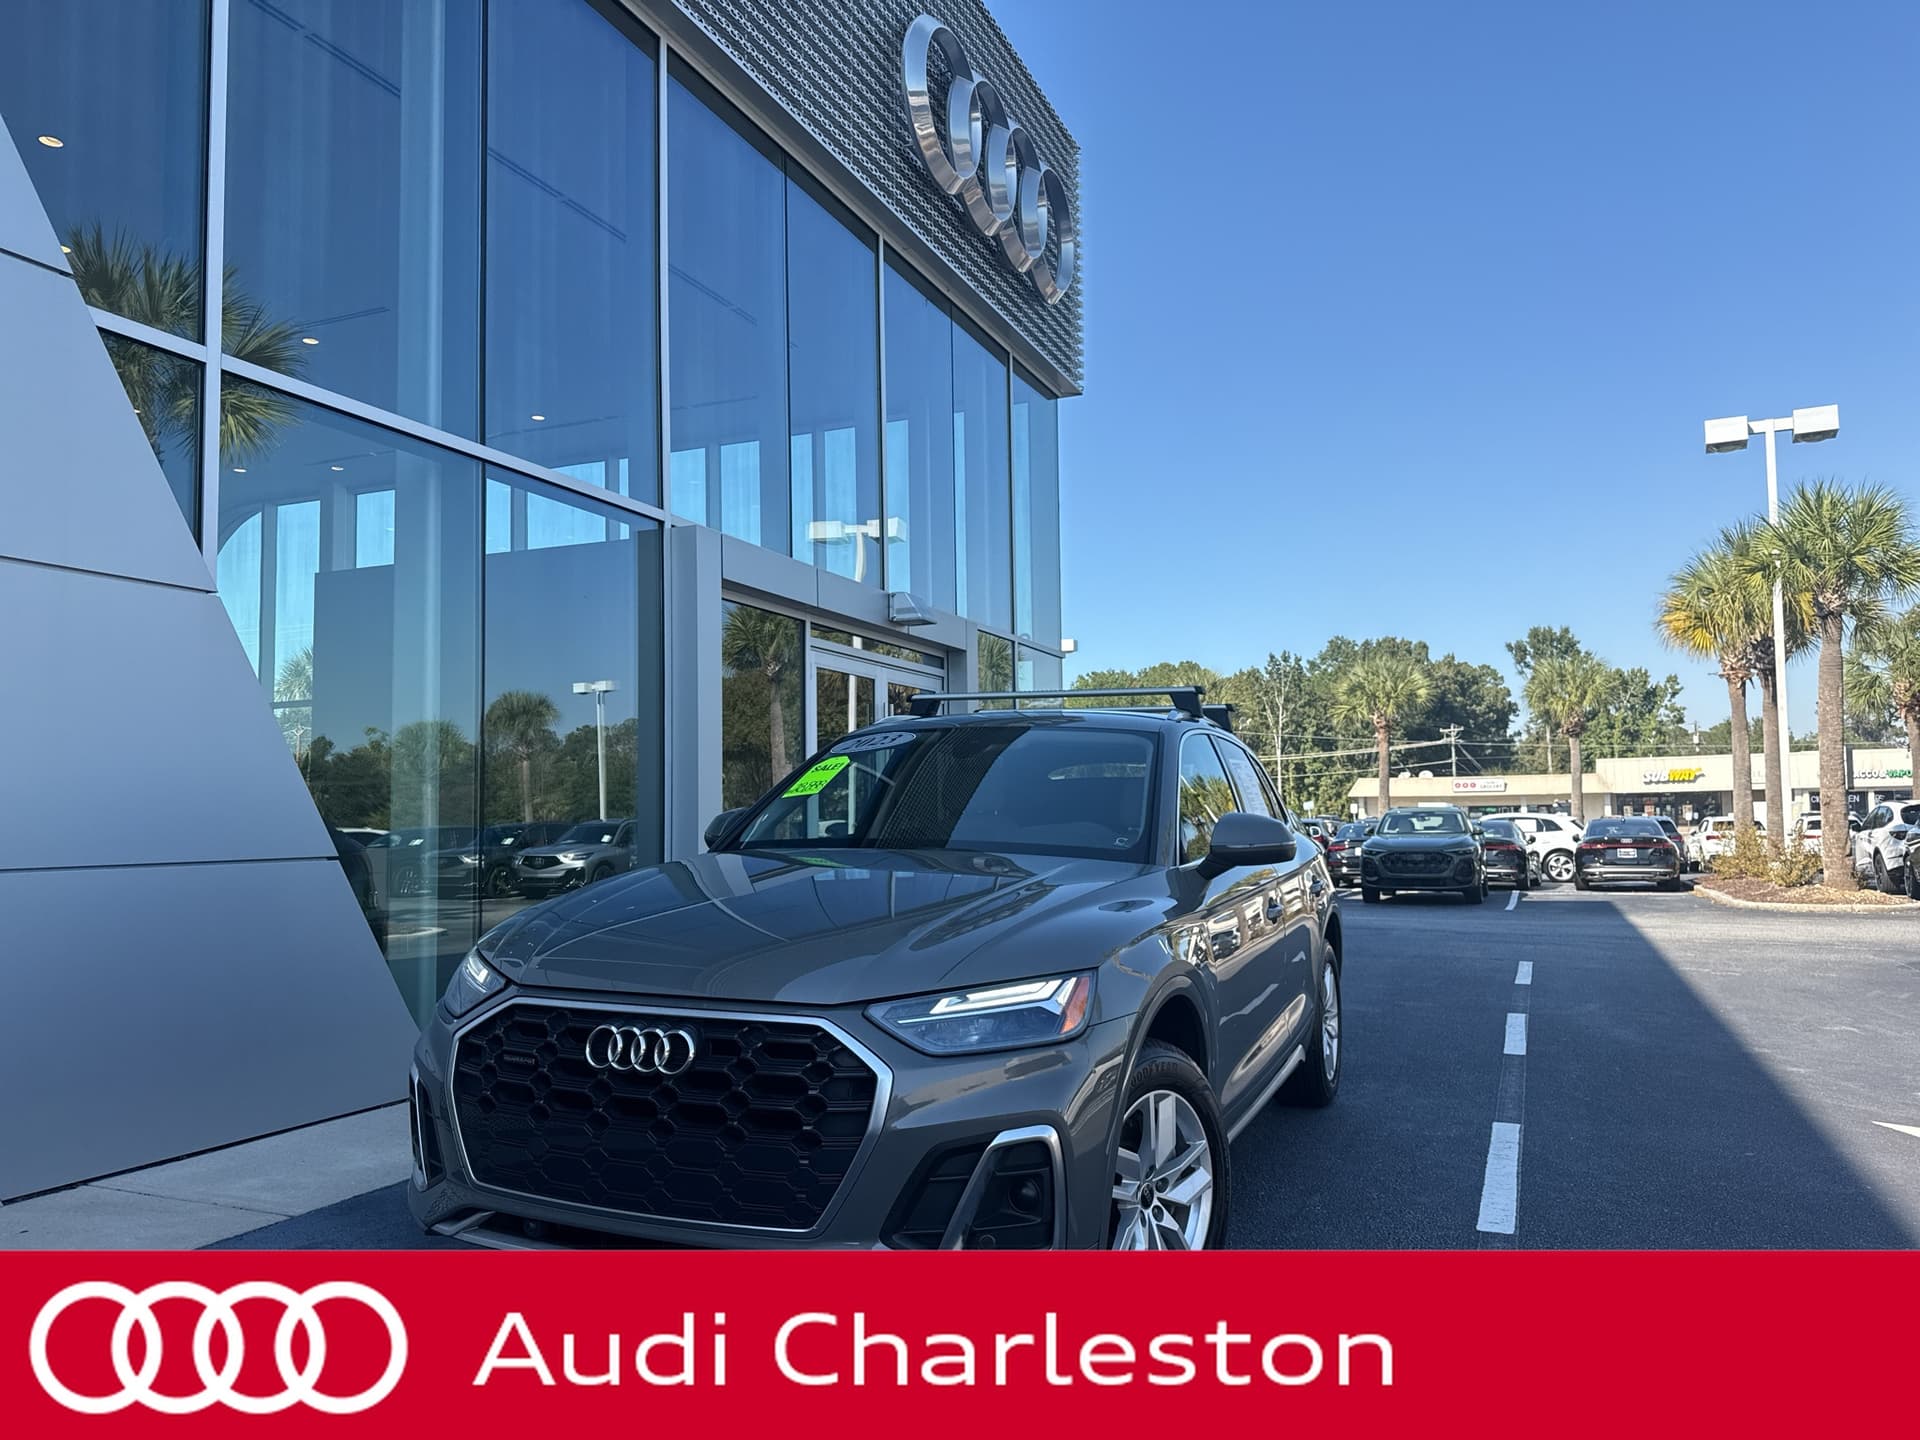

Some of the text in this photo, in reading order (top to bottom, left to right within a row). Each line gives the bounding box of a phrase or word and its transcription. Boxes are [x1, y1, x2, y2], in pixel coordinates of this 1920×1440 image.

[1642, 768, 1702, 784] SUBWAY
[1853, 769, 1878, 779] ACCO
[1887, 769, 1914, 778] VAPO
[1130, 1061, 1178, 1087] OODYEAR
